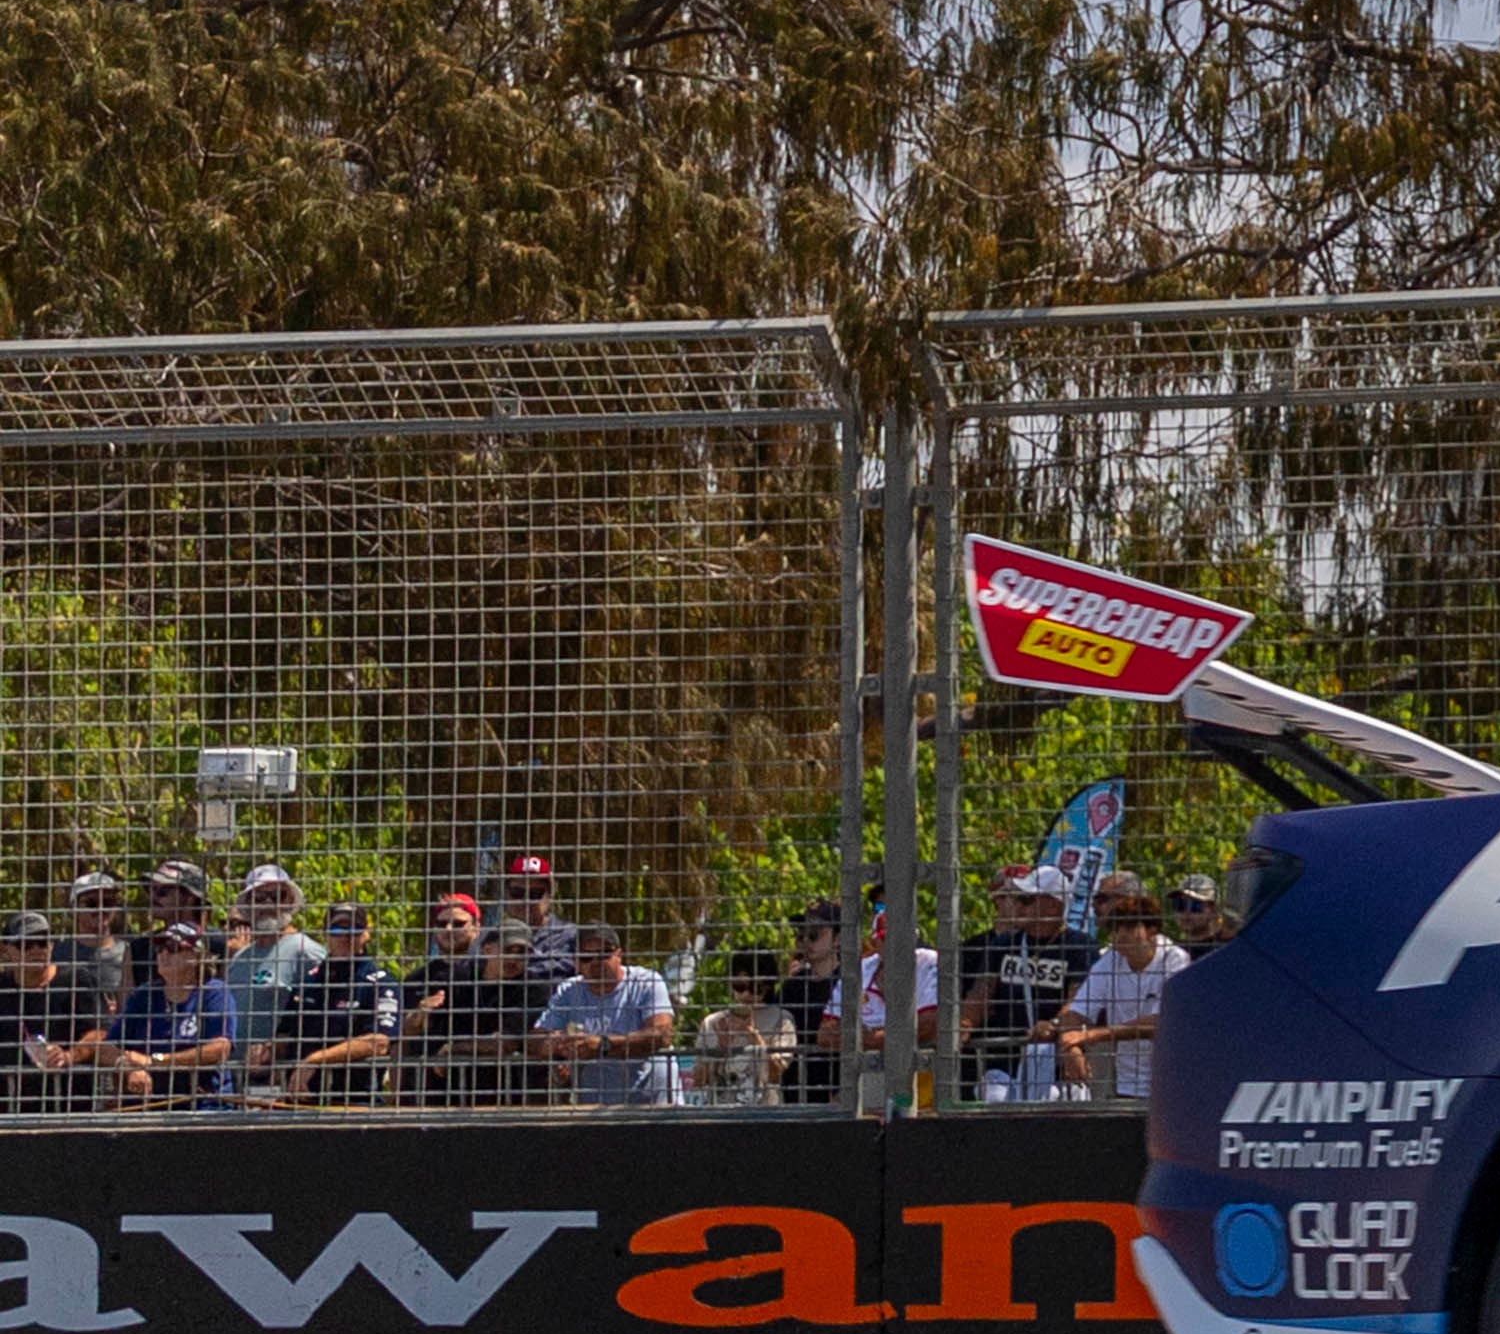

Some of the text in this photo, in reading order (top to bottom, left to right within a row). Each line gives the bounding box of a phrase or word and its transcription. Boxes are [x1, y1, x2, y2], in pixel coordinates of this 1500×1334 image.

[978, 568, 1224, 659] SUPERCHEAP
[1032, 630, 1117, 666] AUTO
[1259, 1079, 1464, 1124] AMPLIFY
[1218, 1126, 1444, 1168] Premium Fuels
[1288, 1200, 1419, 1248] QUAD
[1291, 1252, 1414, 1300] LOCK
